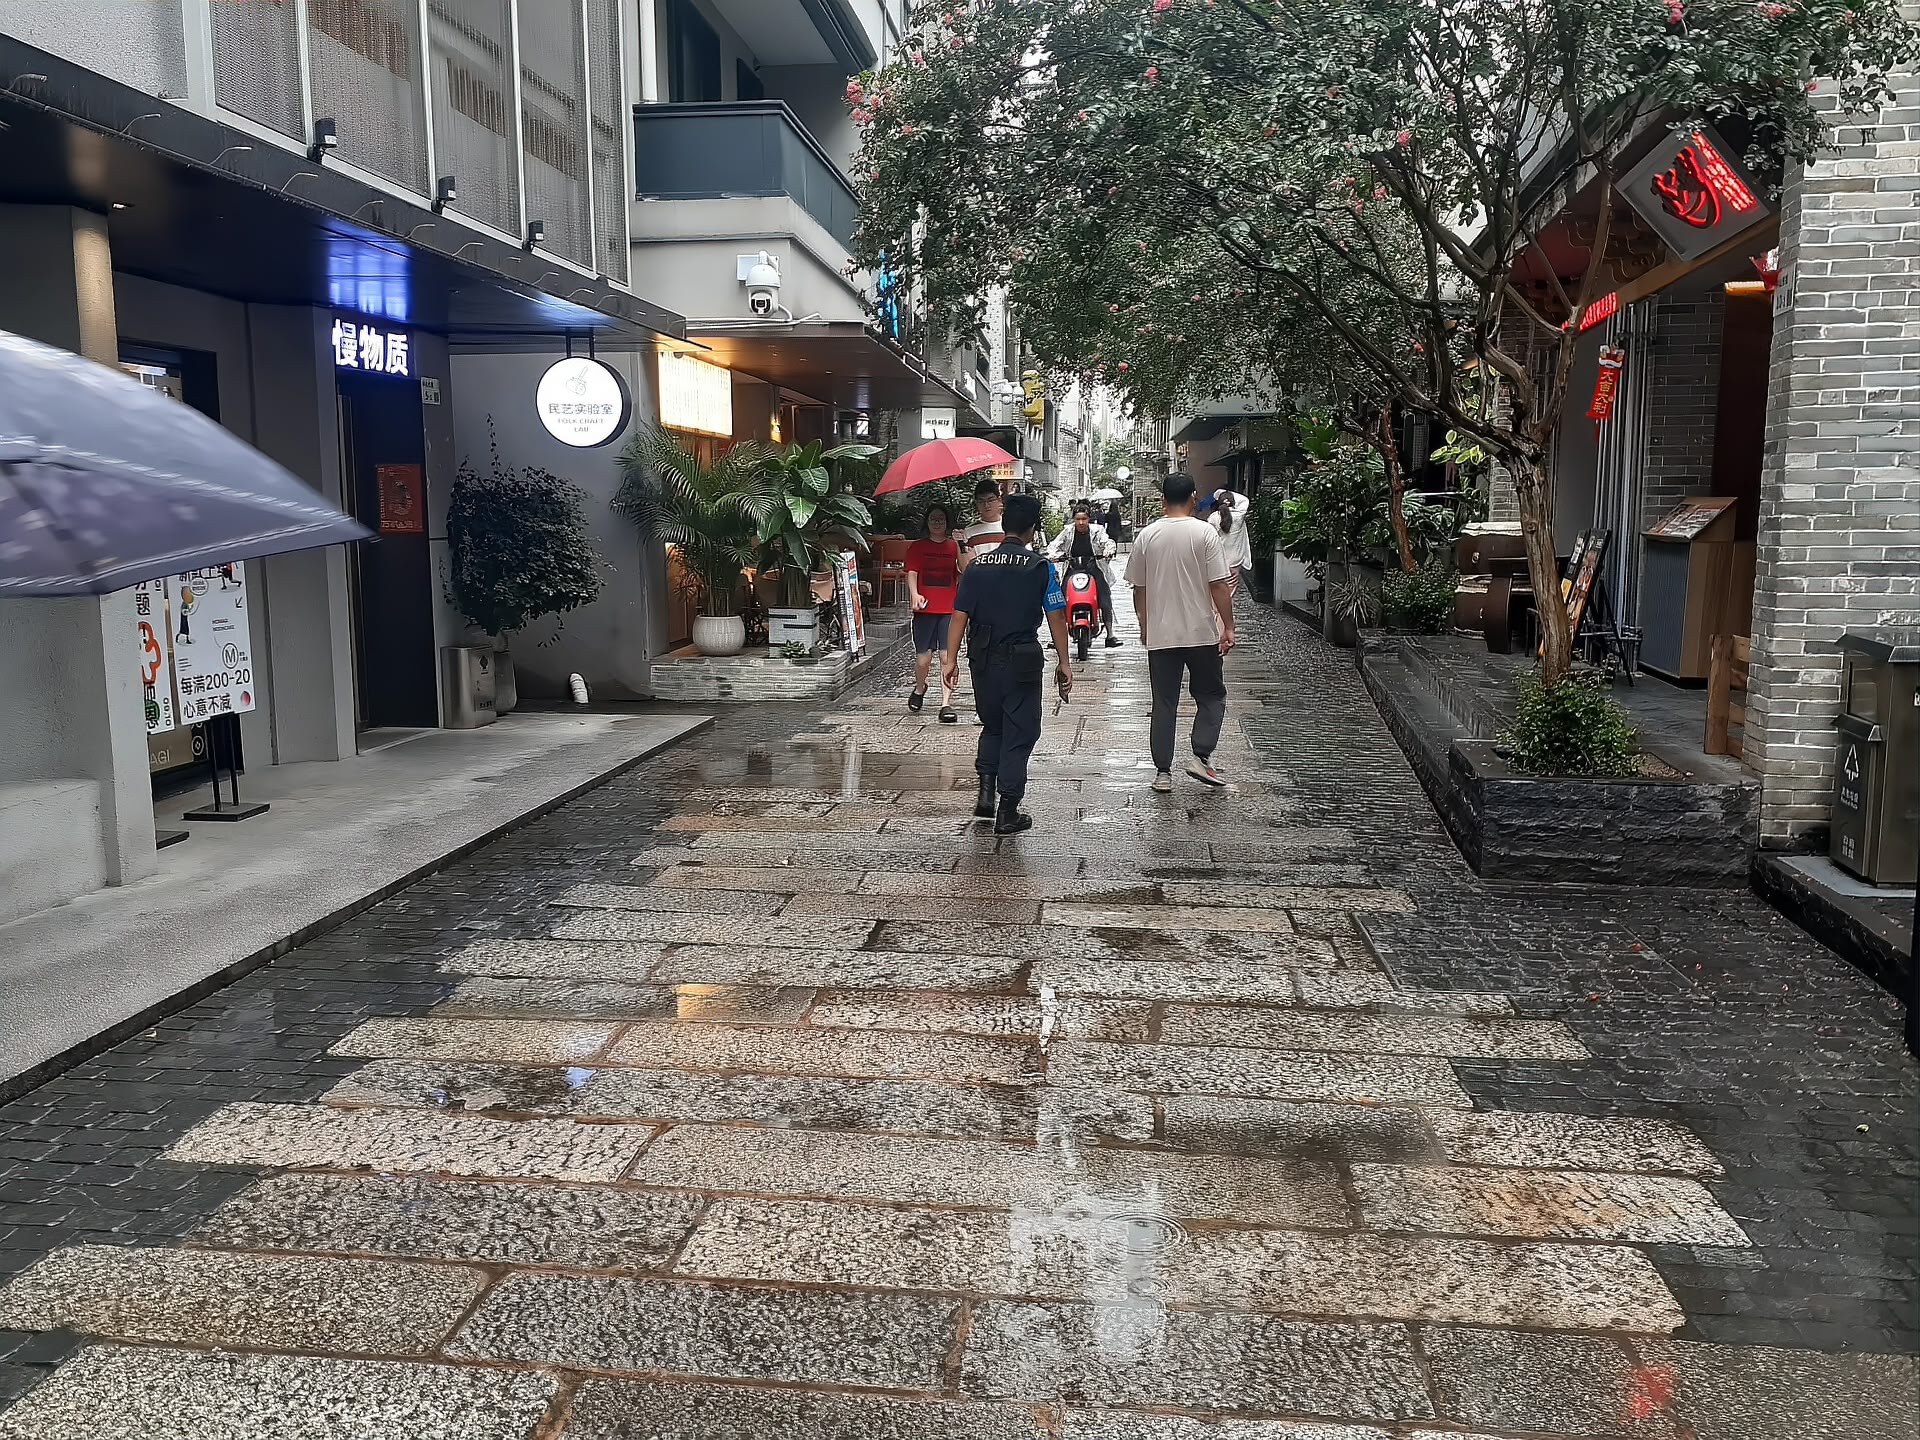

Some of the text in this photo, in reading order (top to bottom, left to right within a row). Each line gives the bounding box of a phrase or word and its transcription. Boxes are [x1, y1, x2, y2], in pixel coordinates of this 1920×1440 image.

[332, 318, 409, 376] 慢物质
[549, 403, 613, 415] 民艺实验室
[974, 553, 1031, 566] SECURITY
[184, 693, 232, 718] 心意不减
